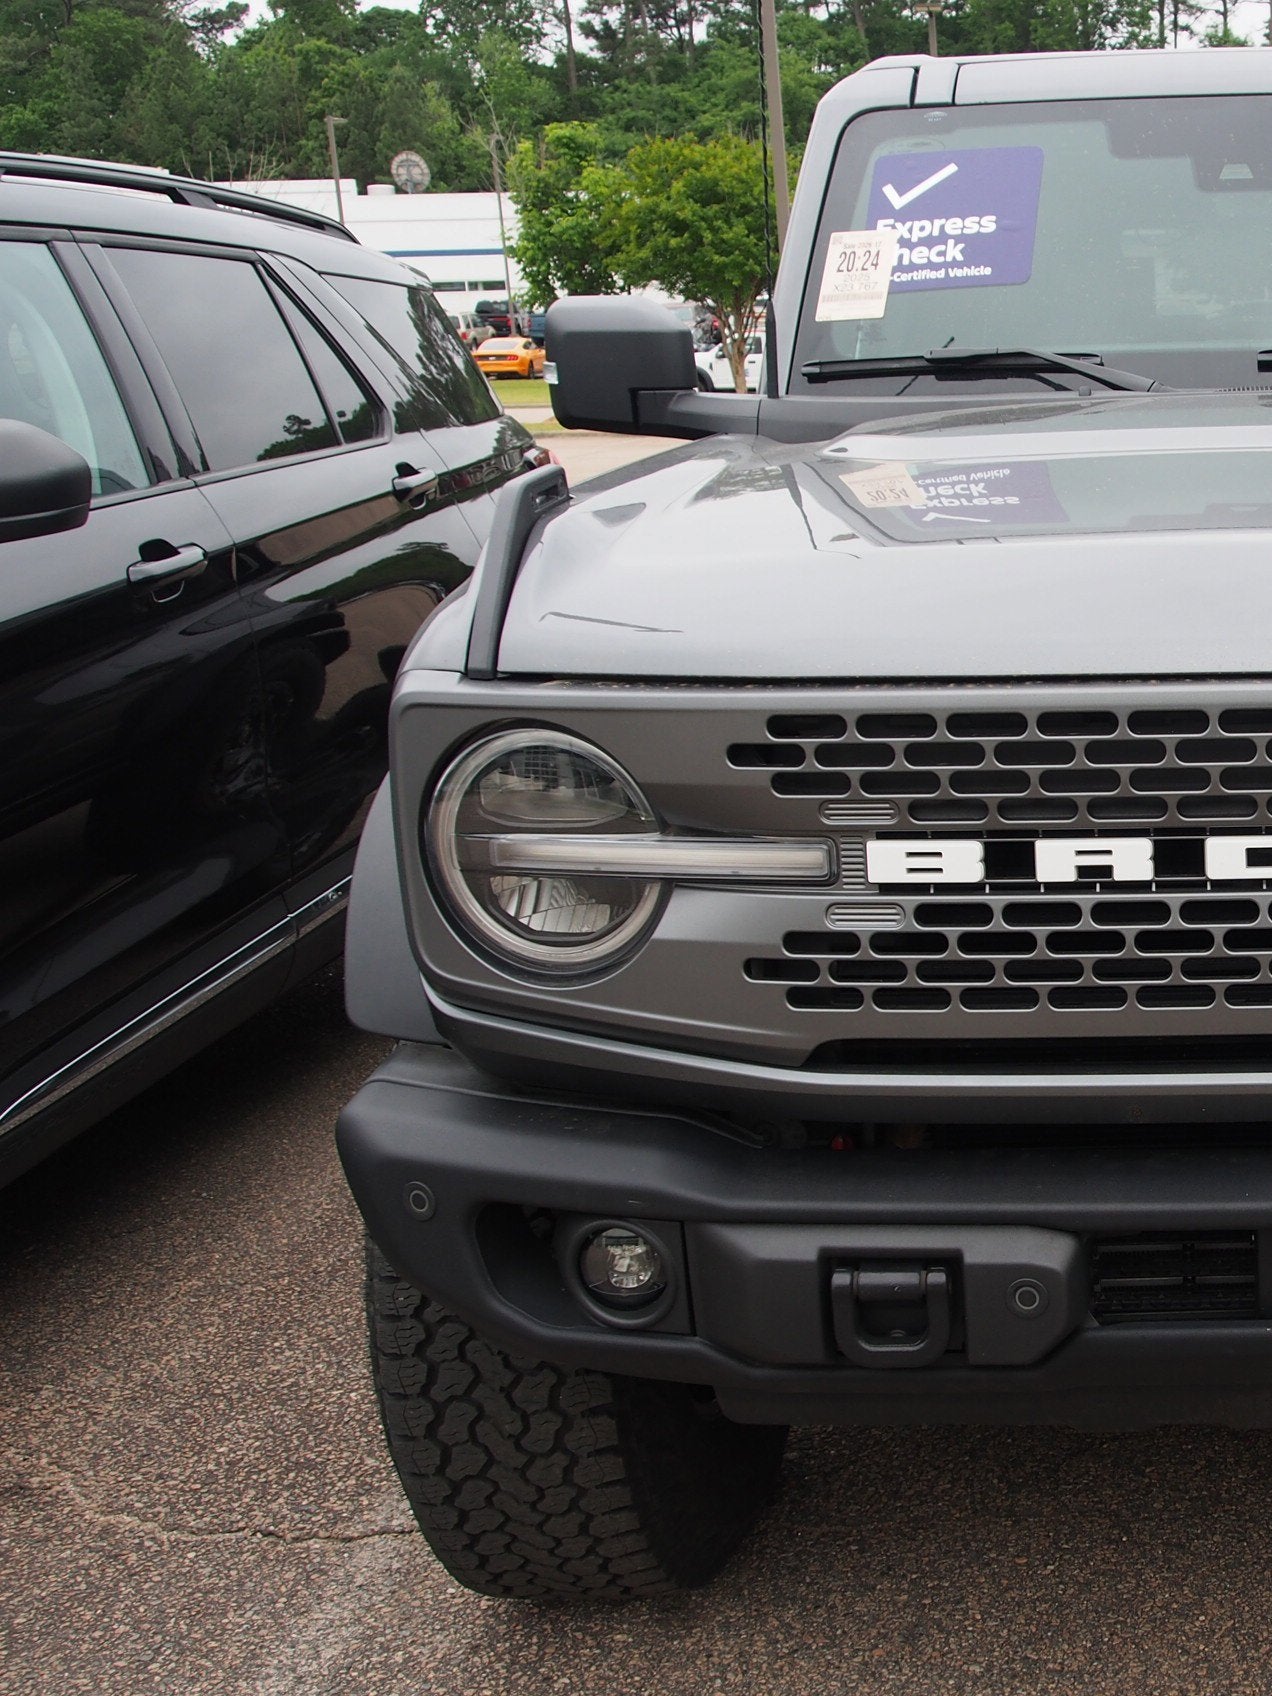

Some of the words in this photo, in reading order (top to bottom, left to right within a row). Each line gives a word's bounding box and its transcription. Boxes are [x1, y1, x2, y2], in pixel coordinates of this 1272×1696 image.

[876, 215, 997, 242] Express
[836, 250, 881, 273] 20:24
[893, 239, 965, 266] heck
[948, 265, 993, 277] Vehicle
